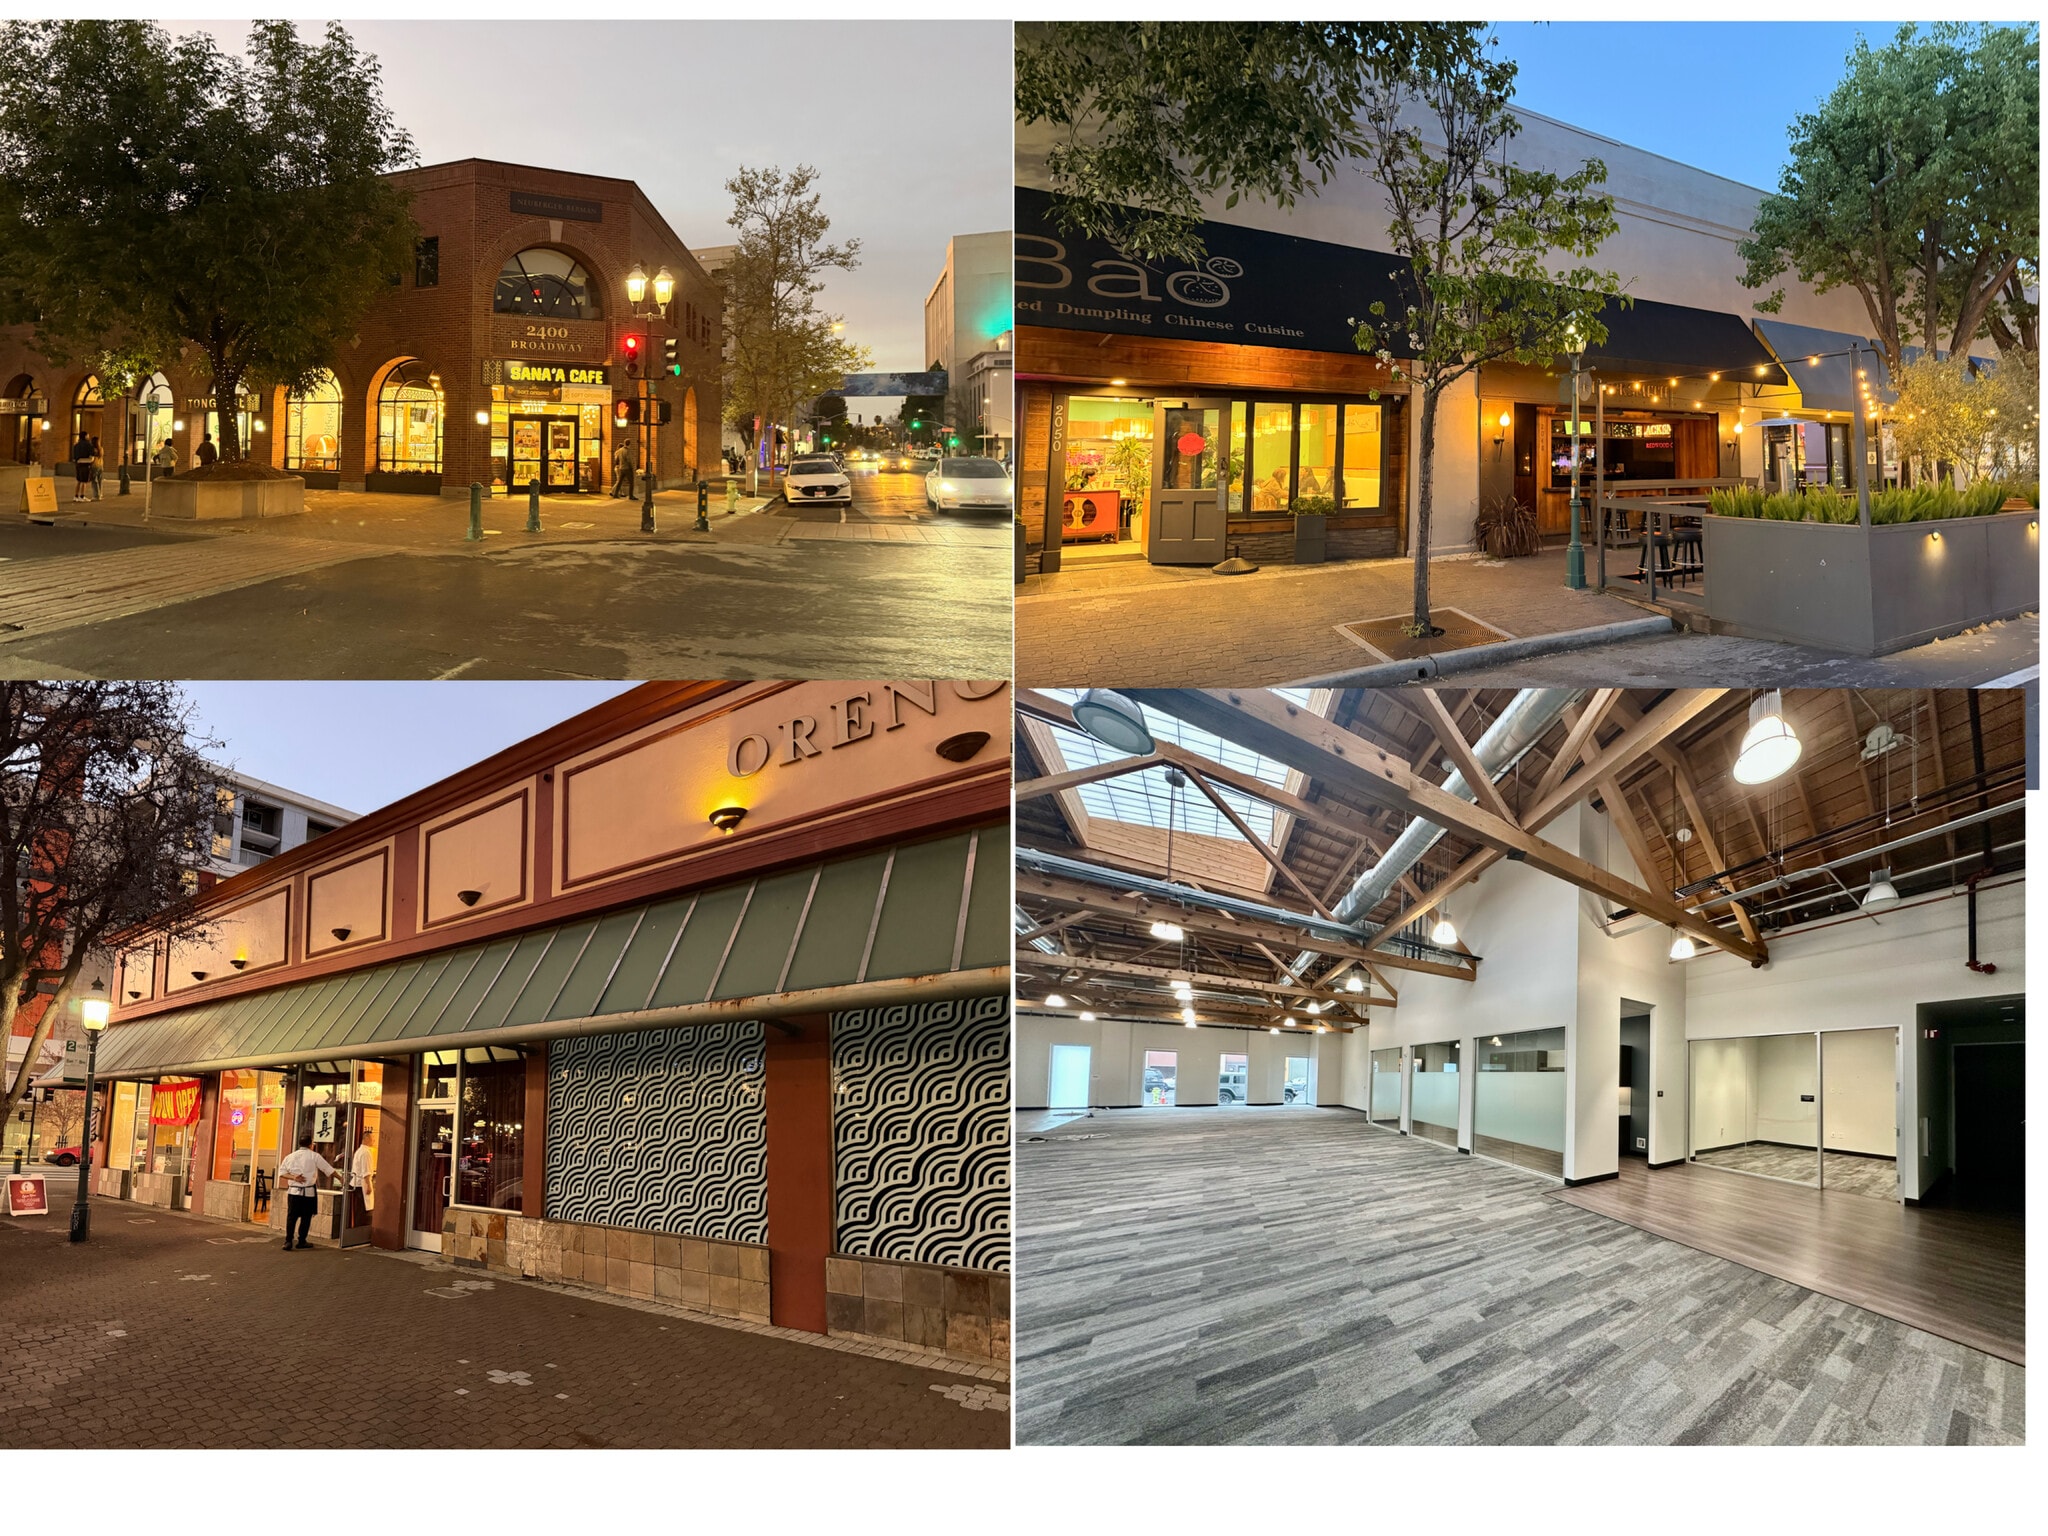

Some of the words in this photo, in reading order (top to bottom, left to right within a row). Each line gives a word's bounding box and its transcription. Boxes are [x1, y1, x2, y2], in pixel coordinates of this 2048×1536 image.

[1057, 302, 1152, 325] Dumpling
[1164, 313, 1234, 332] Chinese
[1244, 322, 1305, 338] Cuisine
[526, 325, 568, 340] 2400
[511, 340, 585, 352] BROADWAY
[510, 366, 565, 382] SANA'A
[569, 369, 603, 385] CAFE
[188, 398, 217, 409] TONG
[1052, 405, 1064, 452] 2050
[68, 1041, 75, 1050] 2
[152, 1090, 175, 1119] NOW
